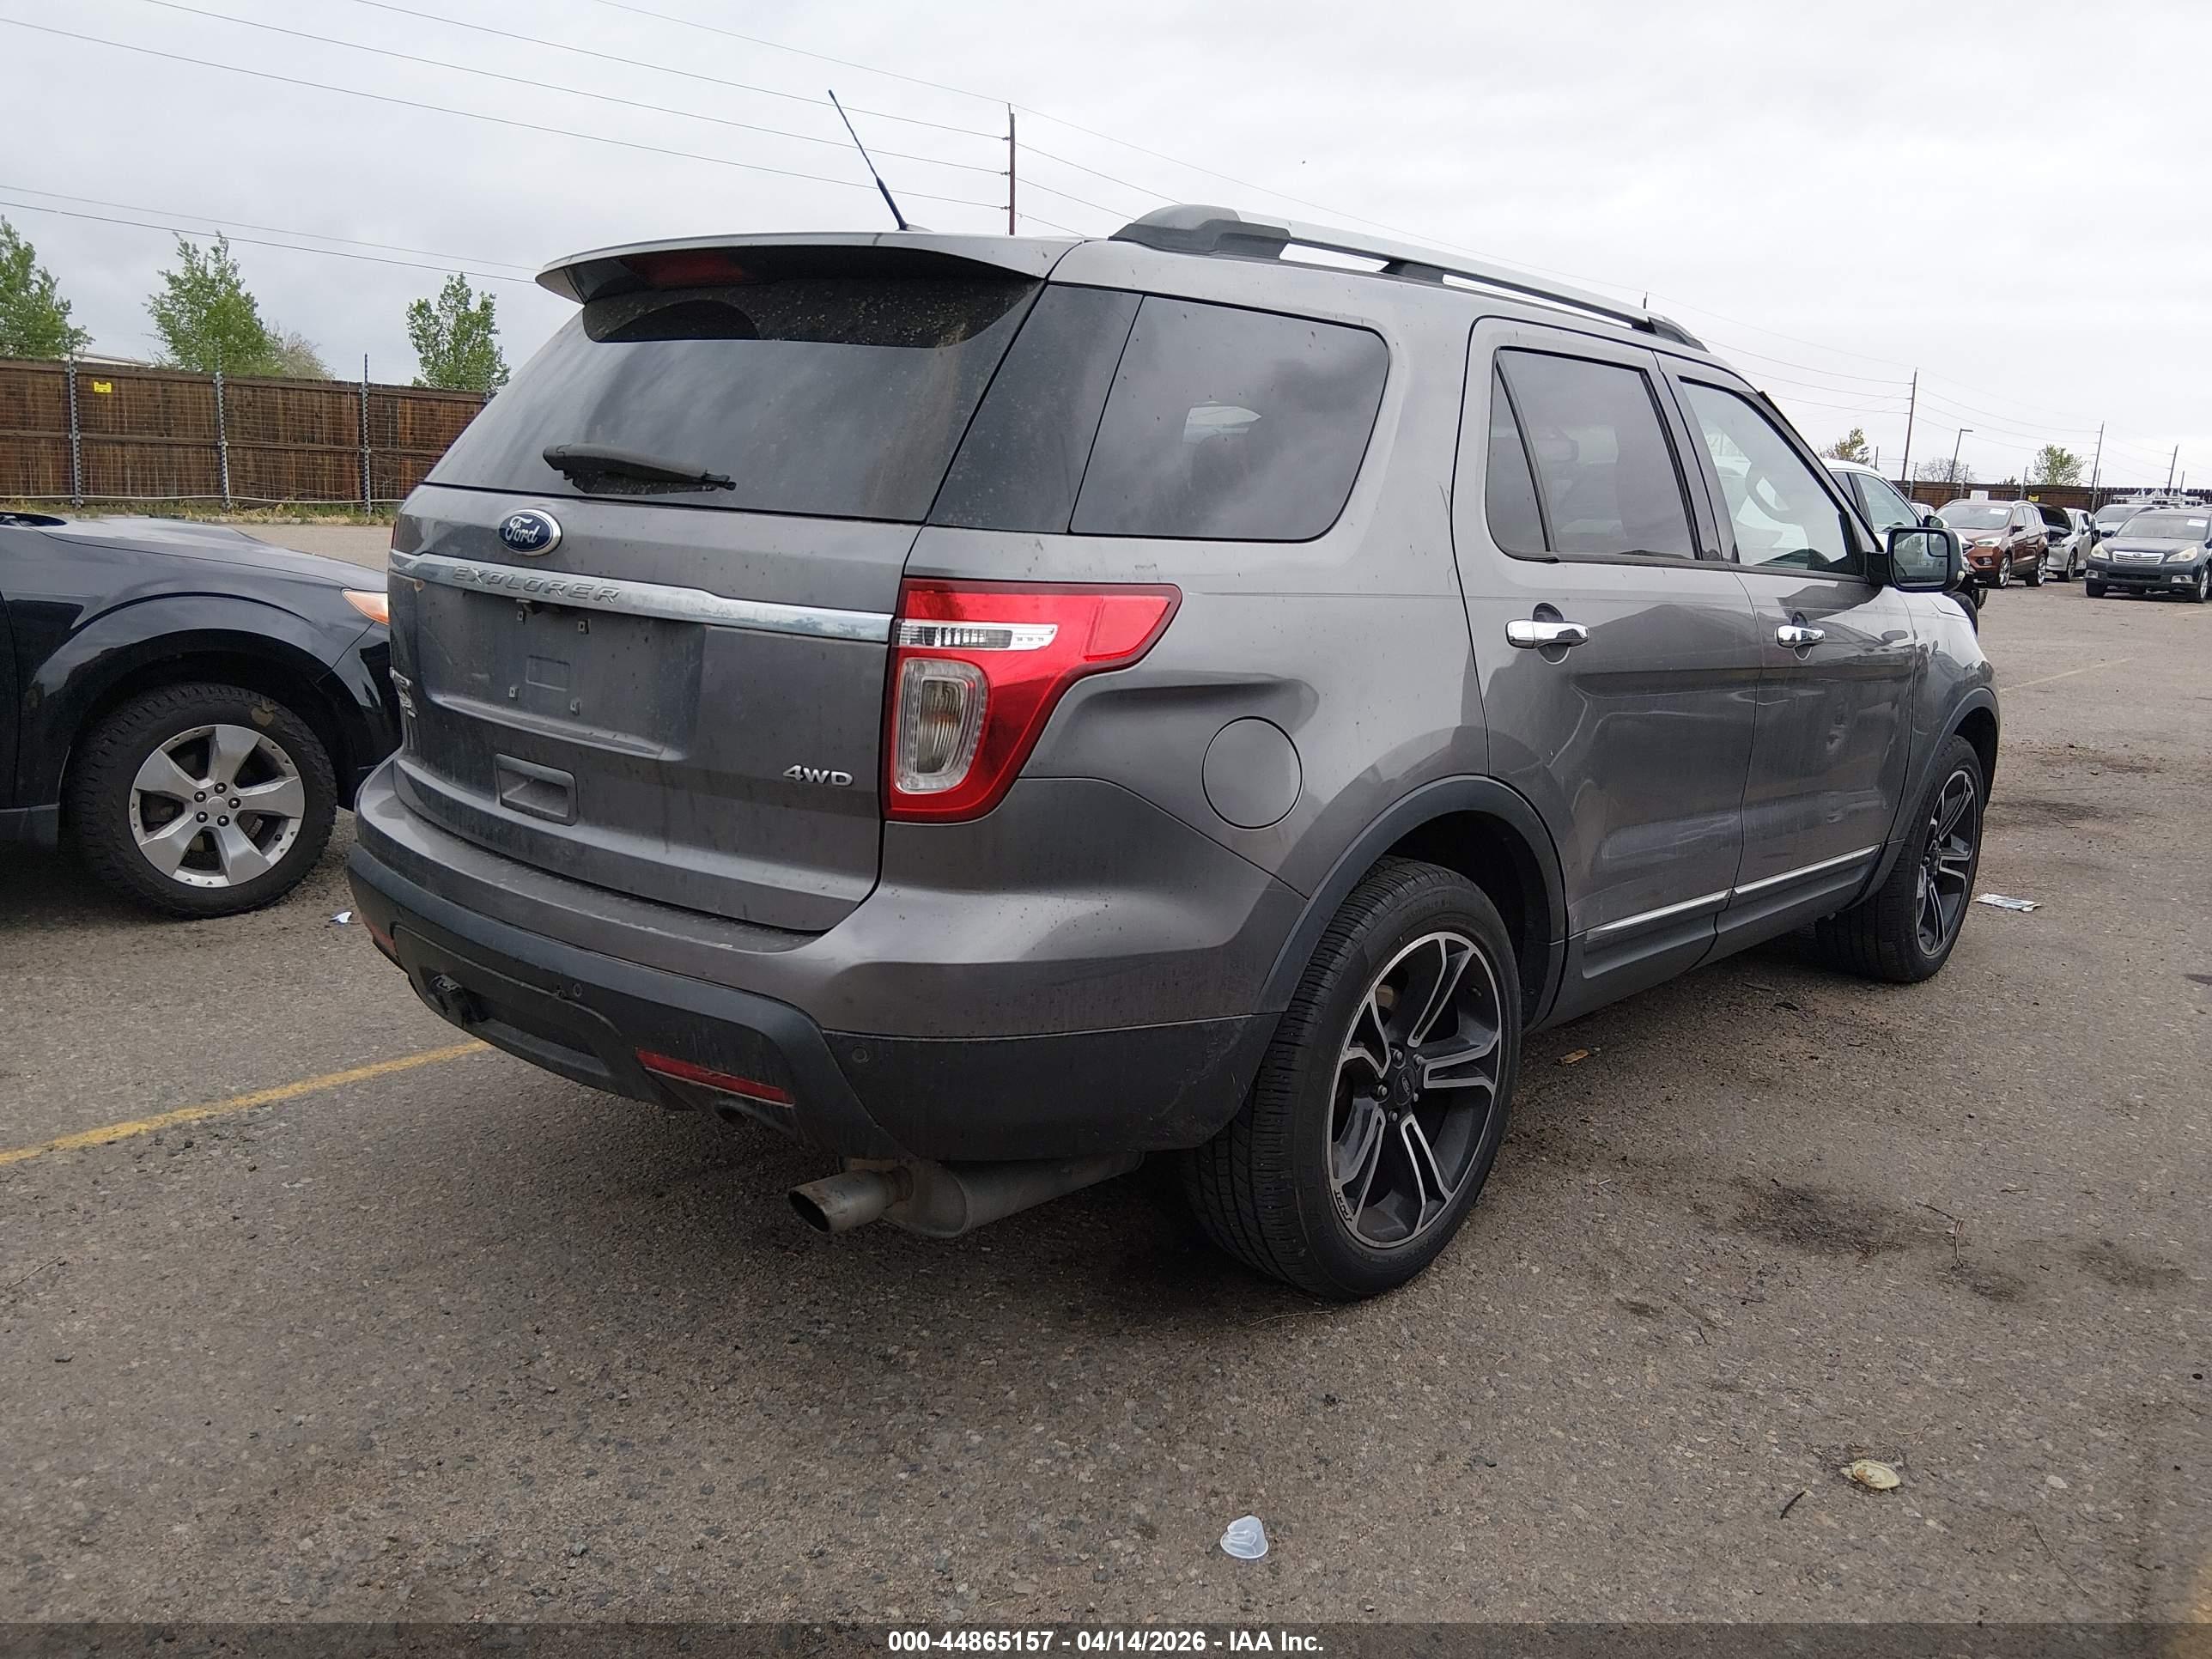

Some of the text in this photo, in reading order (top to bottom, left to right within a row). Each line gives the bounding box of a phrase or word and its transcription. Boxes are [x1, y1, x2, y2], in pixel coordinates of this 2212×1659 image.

[505, 515, 541, 544] Ford
[452, 565, 622, 604] EXPLORER
[782, 764, 853, 786] 4WD
